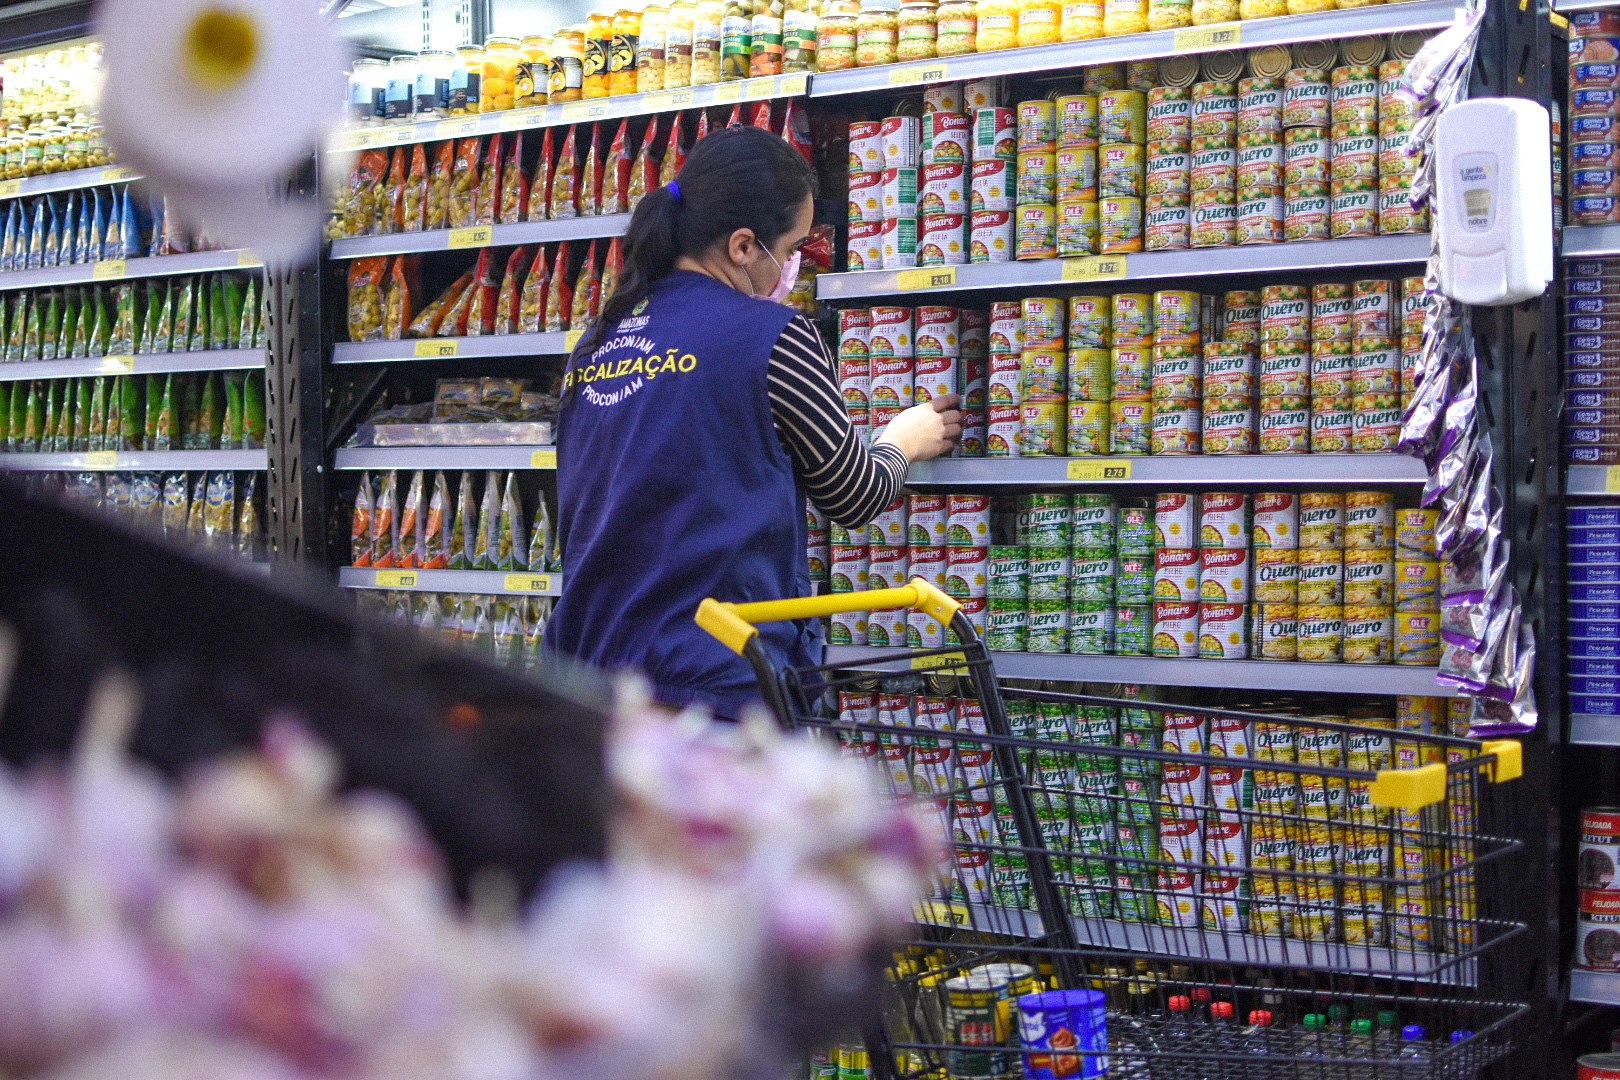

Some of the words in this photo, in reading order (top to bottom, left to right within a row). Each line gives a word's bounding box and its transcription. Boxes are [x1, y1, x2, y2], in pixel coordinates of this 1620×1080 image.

[924, 71, 942, 80] 3,32
[1285, 85, 1328, 102] Quero
[1195, 98, 1237, 116] Quero
[925, 167, 954, 178] Bonare
[925, 218, 954, 229] Bonare
[932, 275, 950, 285] 2,18
[873, 309, 903, 323] Bonare
[922, 311, 951, 322] Bonare
[992, 305, 1020, 318] Bonare
[1262, 302, 1304, 320] Quero
[617, 316, 650, 329] AMAZONAS
[592, 336, 655, 363] PROCON/AM
[877, 361, 907, 372] Bonare
[582, 377, 643, 406] PROCON/AM
[990, 407, 1019, 418] Bonare
[1262, 412, 1305, 430] Quero
[1356, 411, 1399, 429] Quero
[1106, 469, 1123, 477] 2,75
[911, 499, 940, 511] Bonare
[951, 499, 982, 512] Bonare
[1204, 498, 1235, 509] Bonare
[834, 548, 862, 559] Bonare
[911, 550, 941, 561] Bonare
[949, 550, 979, 562] Bonare
[1159, 552, 1191, 564] Bonare
[1205, 552, 1237, 564] Bonare
[989, 561, 1028, 576] Quero
[1158, 606, 1189, 618] Bonare
[1203, 608, 1235, 619] Bonare
[1299, 621, 1341, 637] Quero
